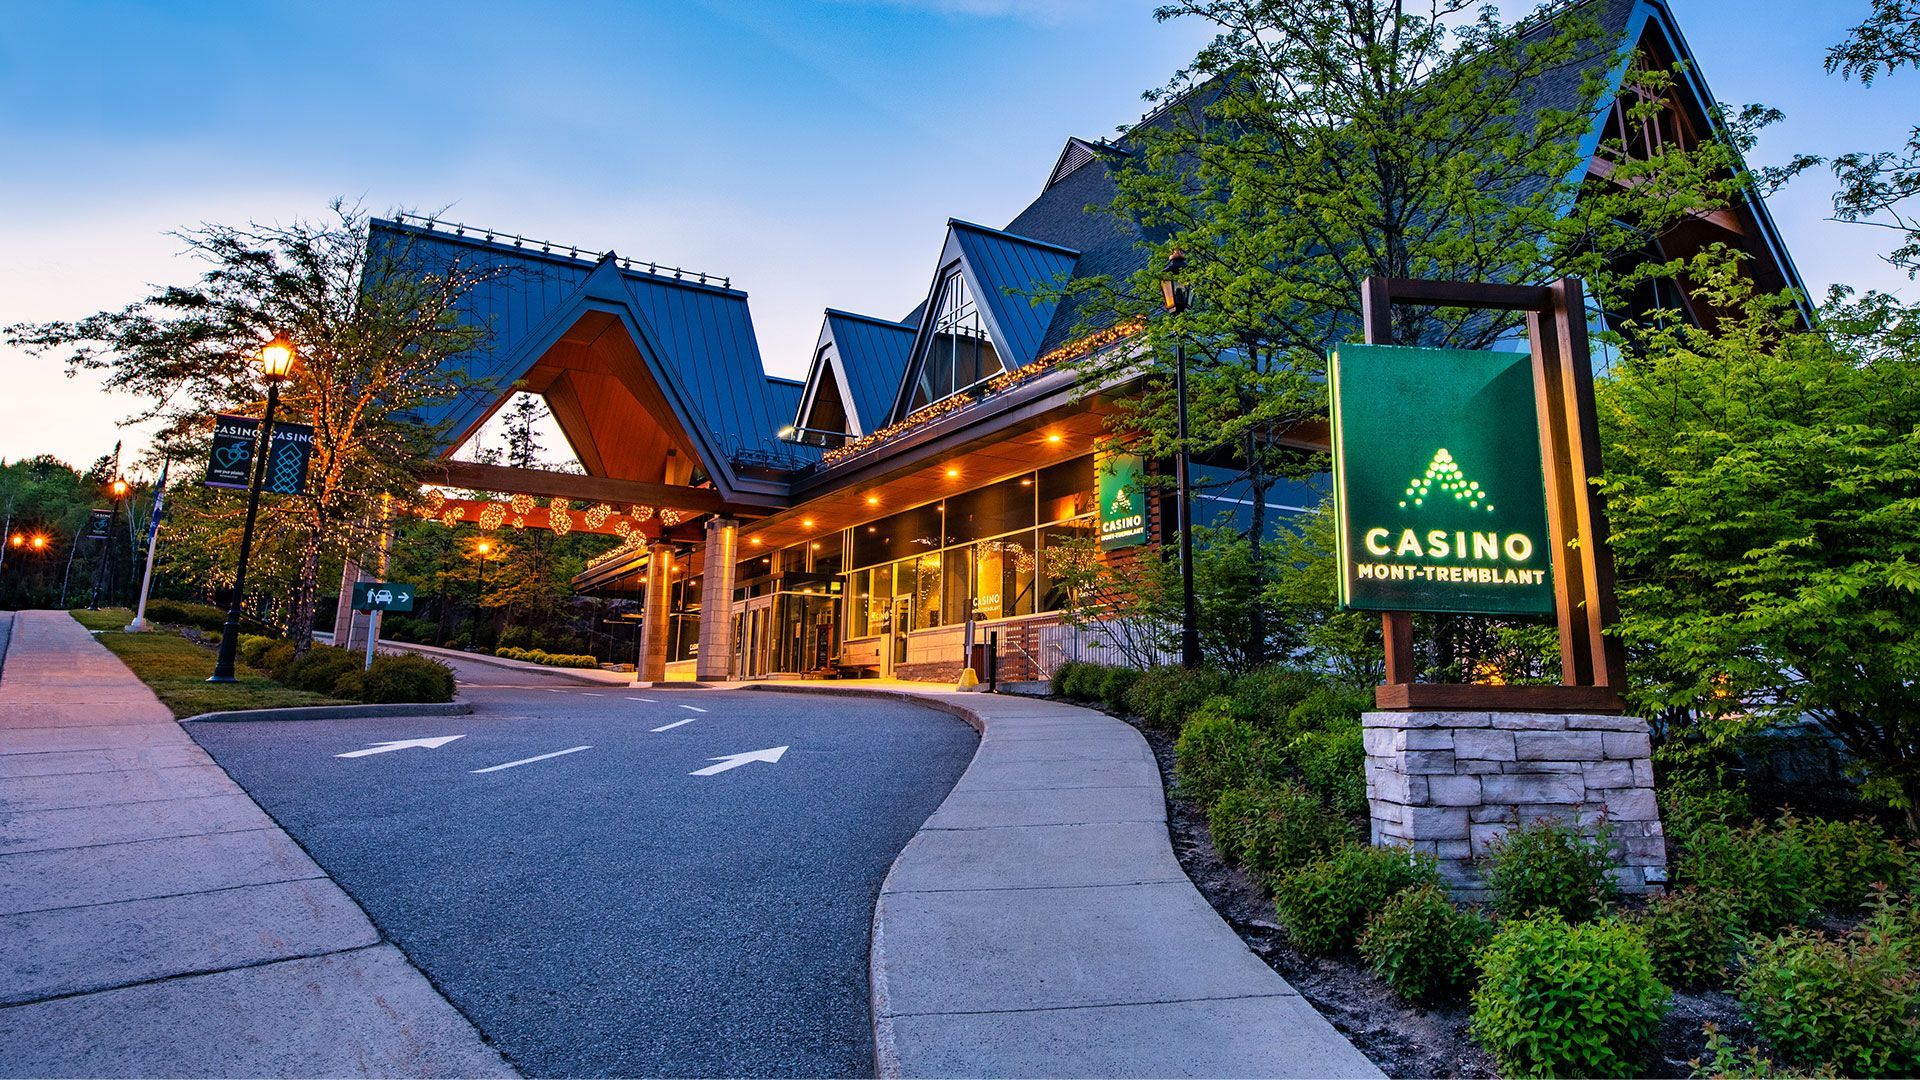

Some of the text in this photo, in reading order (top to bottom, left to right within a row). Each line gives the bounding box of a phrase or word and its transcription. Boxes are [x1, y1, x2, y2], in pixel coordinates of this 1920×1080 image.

[1102, 515, 1142, 533] CASINO
[1365, 527, 1533, 562] CASINO
[1358, 563, 1545, 585] MONT-TREMBLANT
[972, 594, 1000, 607] CASINO
